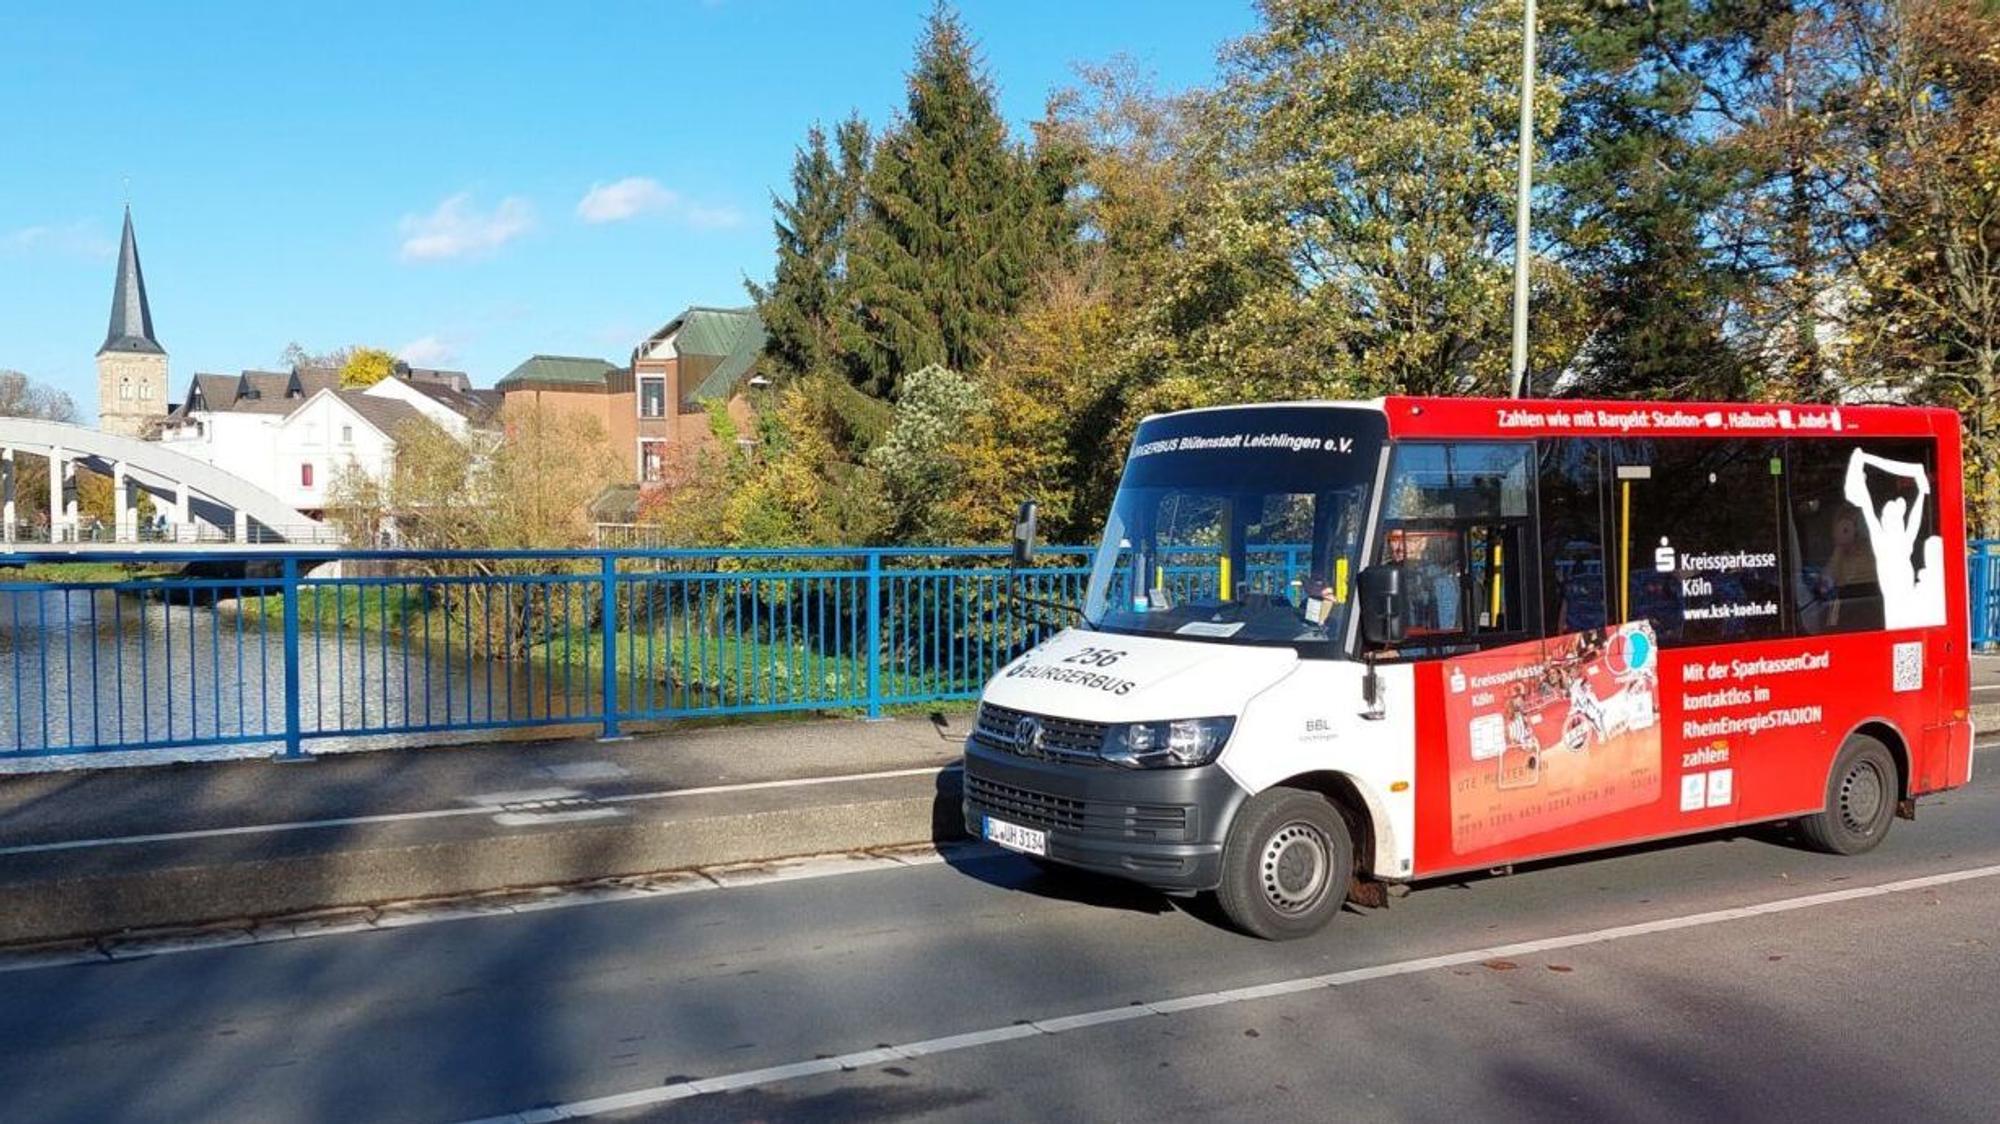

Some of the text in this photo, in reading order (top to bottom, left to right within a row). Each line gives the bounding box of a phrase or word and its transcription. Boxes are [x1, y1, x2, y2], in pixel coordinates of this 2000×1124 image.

[1497, 410, 1545, 428] Zahlen
[1546, 410, 1571, 428] wie
[1573, 410, 1596, 428] mit
[1243, 433, 1321, 452] Leichlingen
[1324, 437, 1354, 453] e.V.
[1681, 550, 1776, 573] Kreissparkasse
[1682, 577, 1712, 597] Köln
[1684, 601, 1778, 620] www.ksk-koeln.de
[1062, 647, 1127, 667] 256
[1683, 651, 1830, 683] Mit der SparkassenCard
[1471, 664, 1544, 688] Kreissparkasse
[1683, 685, 1770, 711] kontaktlos im
[1683, 706, 1822, 740] RheinEnergieSTADION
[1682, 746, 1730, 768] zahlen!
